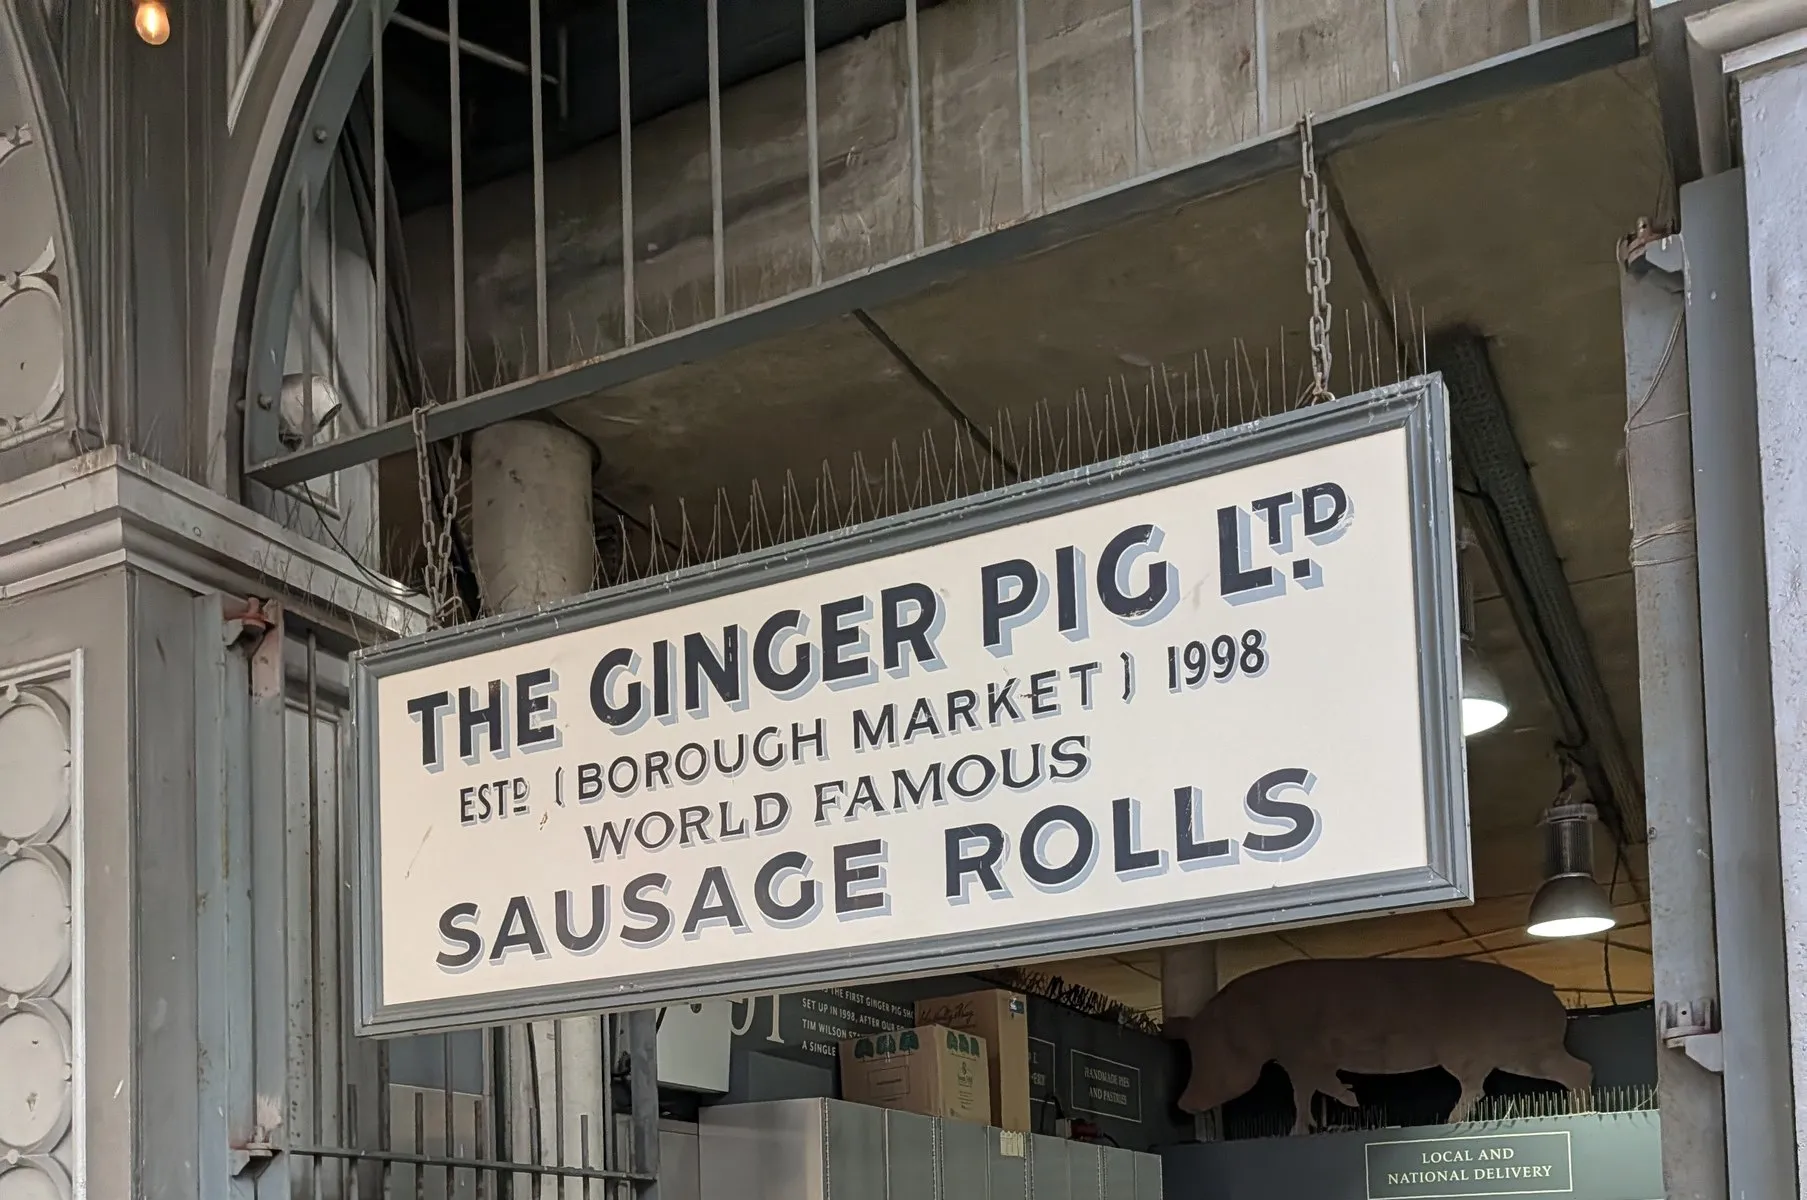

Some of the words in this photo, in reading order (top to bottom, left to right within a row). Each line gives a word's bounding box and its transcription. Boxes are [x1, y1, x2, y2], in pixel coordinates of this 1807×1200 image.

[407, 667, 564, 773] THE
[588, 581, 946, 736] GINGER
[981, 522, 1180, 658] PIG
[1166, 628, 1269, 695] 1998
[583, 789, 791, 863] WORLD
[814, 734, 1091, 825] FAMOUS
[435, 837, 891, 974] SAUSAGE
[944, 767, 1321, 906] ROLLS
[802, 998, 816, 1010] SET
[818, 1002, 828, 1013] UP
[830, 1006, 838, 1016] IN
[860, 1015, 880, 1028] AFTER
[845, 990, 864, 1004] FIRST
[866, 997, 889, 1012] GINGER
[892, 1005, 901, 1015] PIG
[802, 1019, 816, 1030] TIM
[818, 1023, 847, 1038] WILSON
[802, 1041, 808, 1050] A
[810, 1042, 836, 1056] SINGLE
[1422, 1151, 1473, 1164] LOCAL
[1478, 1148, 1514, 1160] AND
[1388, 1169, 1470, 1185] NATIONAL
[1474, 1165, 1552, 1180] DELIVERY
